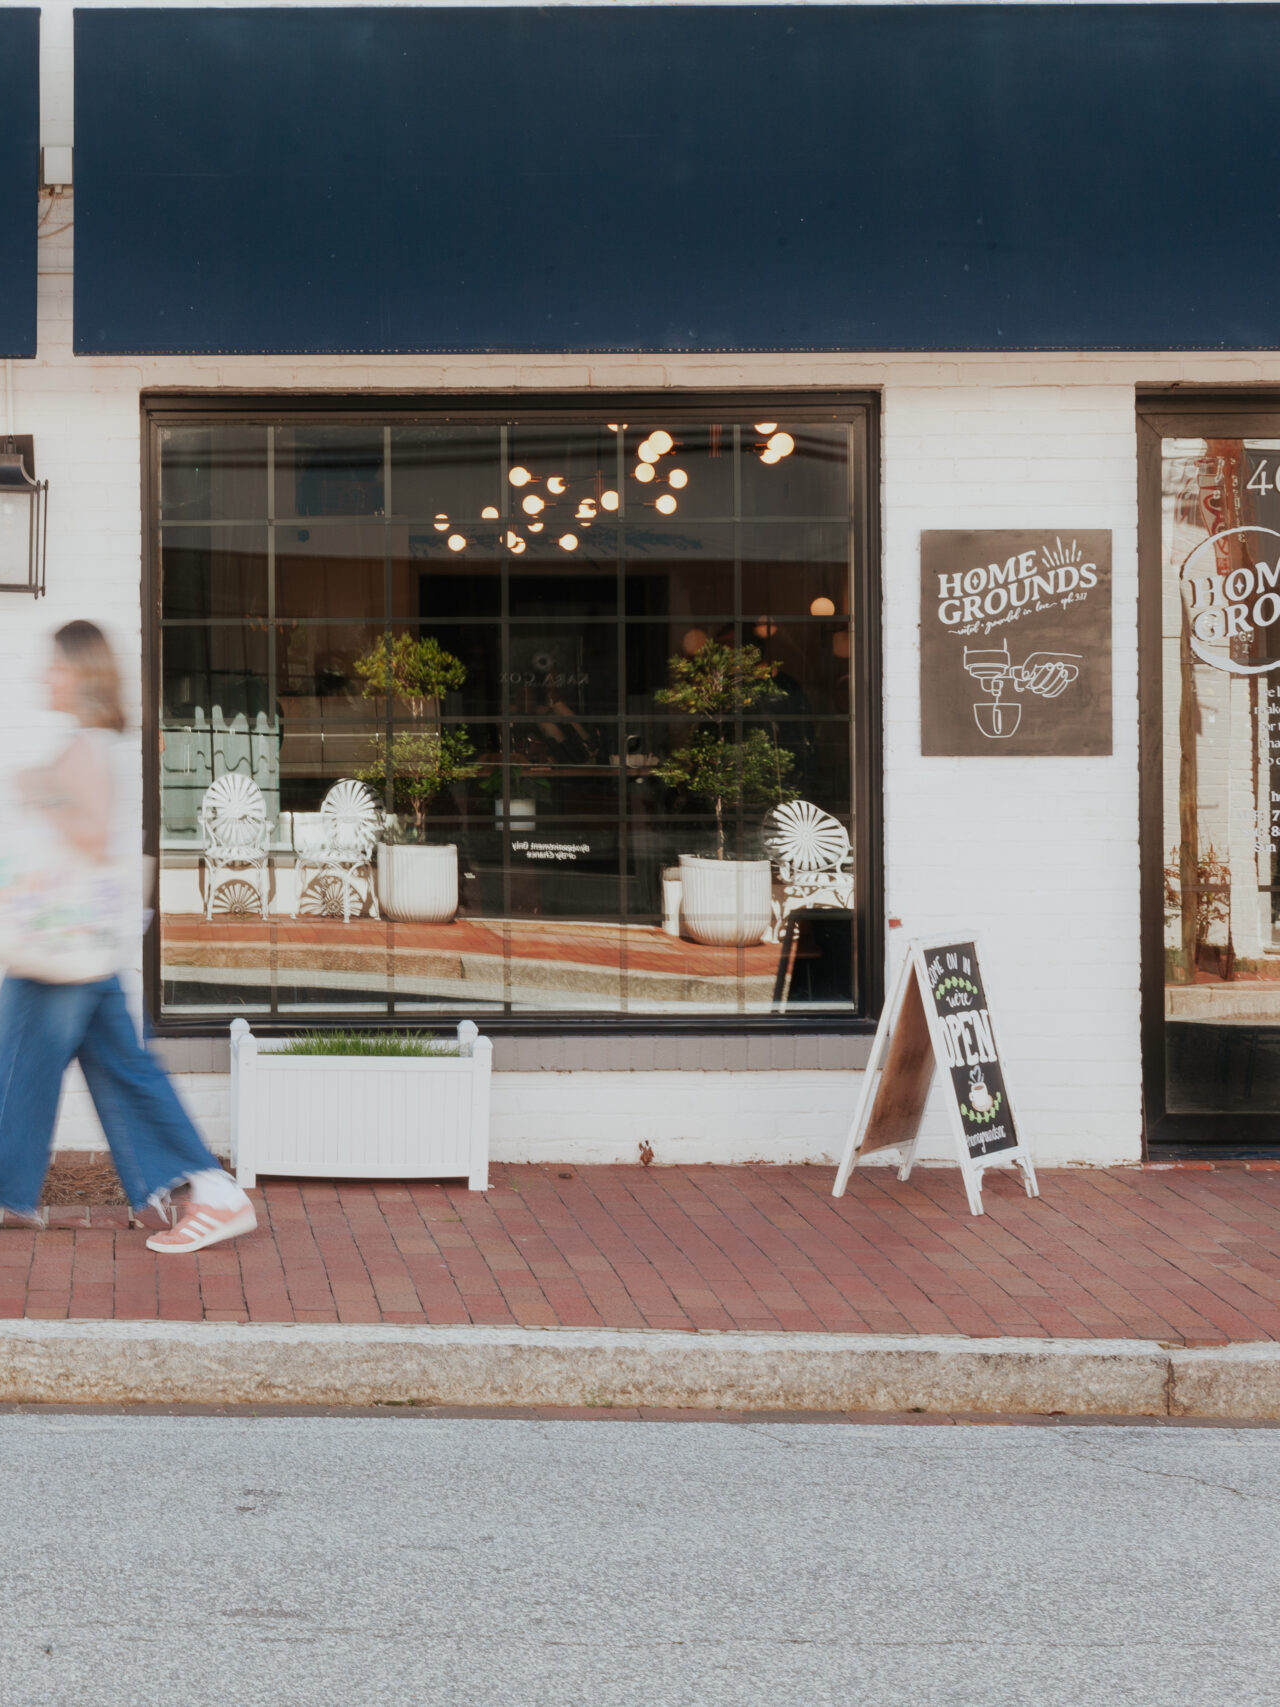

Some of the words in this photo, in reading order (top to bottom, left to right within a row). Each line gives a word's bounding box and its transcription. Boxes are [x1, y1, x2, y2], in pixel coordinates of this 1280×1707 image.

[1246, 459, 1280, 496] 4
[938, 550, 1038, 598] HOME
[938, 563, 1098, 625] GROUNDS
[1022, 608, 1033, 616] in
[1035, 601, 1057, 612] love
[946, 952, 958, 970] ON
[962, 955, 972, 977] IN
[938, 1008, 998, 1068] OPEN
